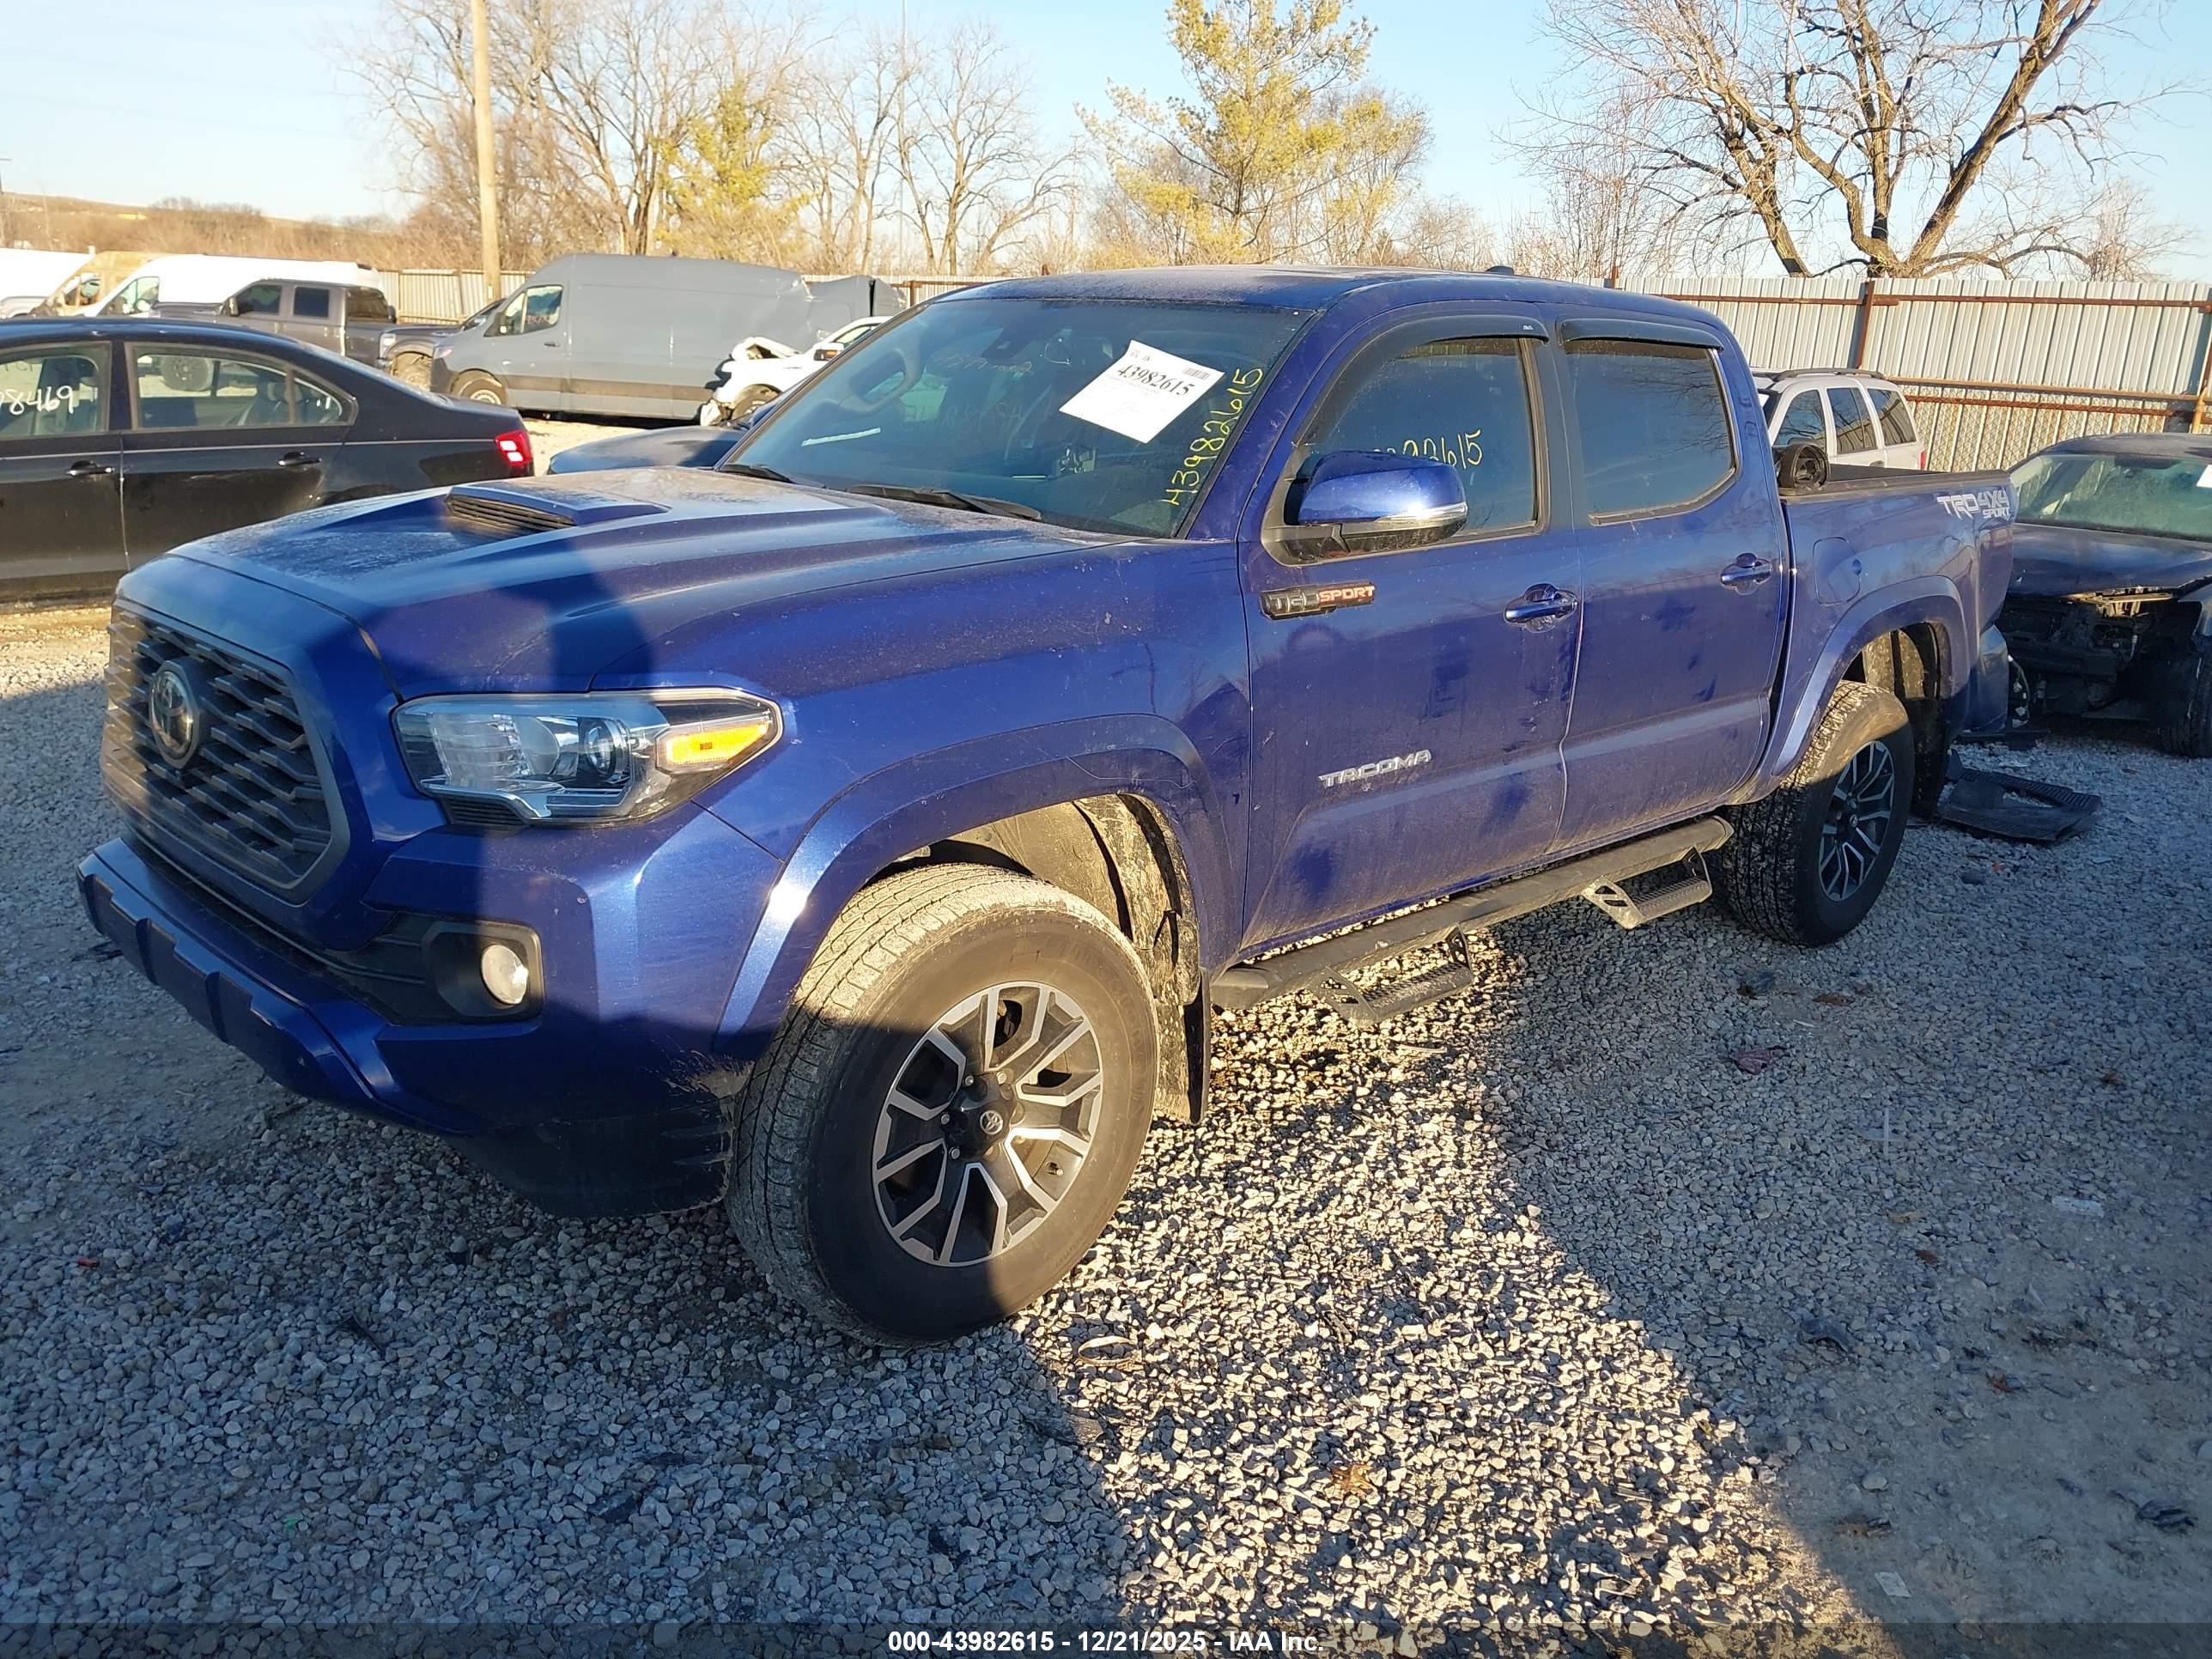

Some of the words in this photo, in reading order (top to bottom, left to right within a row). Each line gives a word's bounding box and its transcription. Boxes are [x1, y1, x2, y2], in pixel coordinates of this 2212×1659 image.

[1117, 364, 1195, 396] 43982615
[1160, 368, 1264, 506] 43982615
[1936, 493, 1978, 520] TRD
[1982, 507, 2011, 520] SPORT
[1318, 586, 1376, 603] SPORT
[1318, 749, 1432, 788] TACOMA
